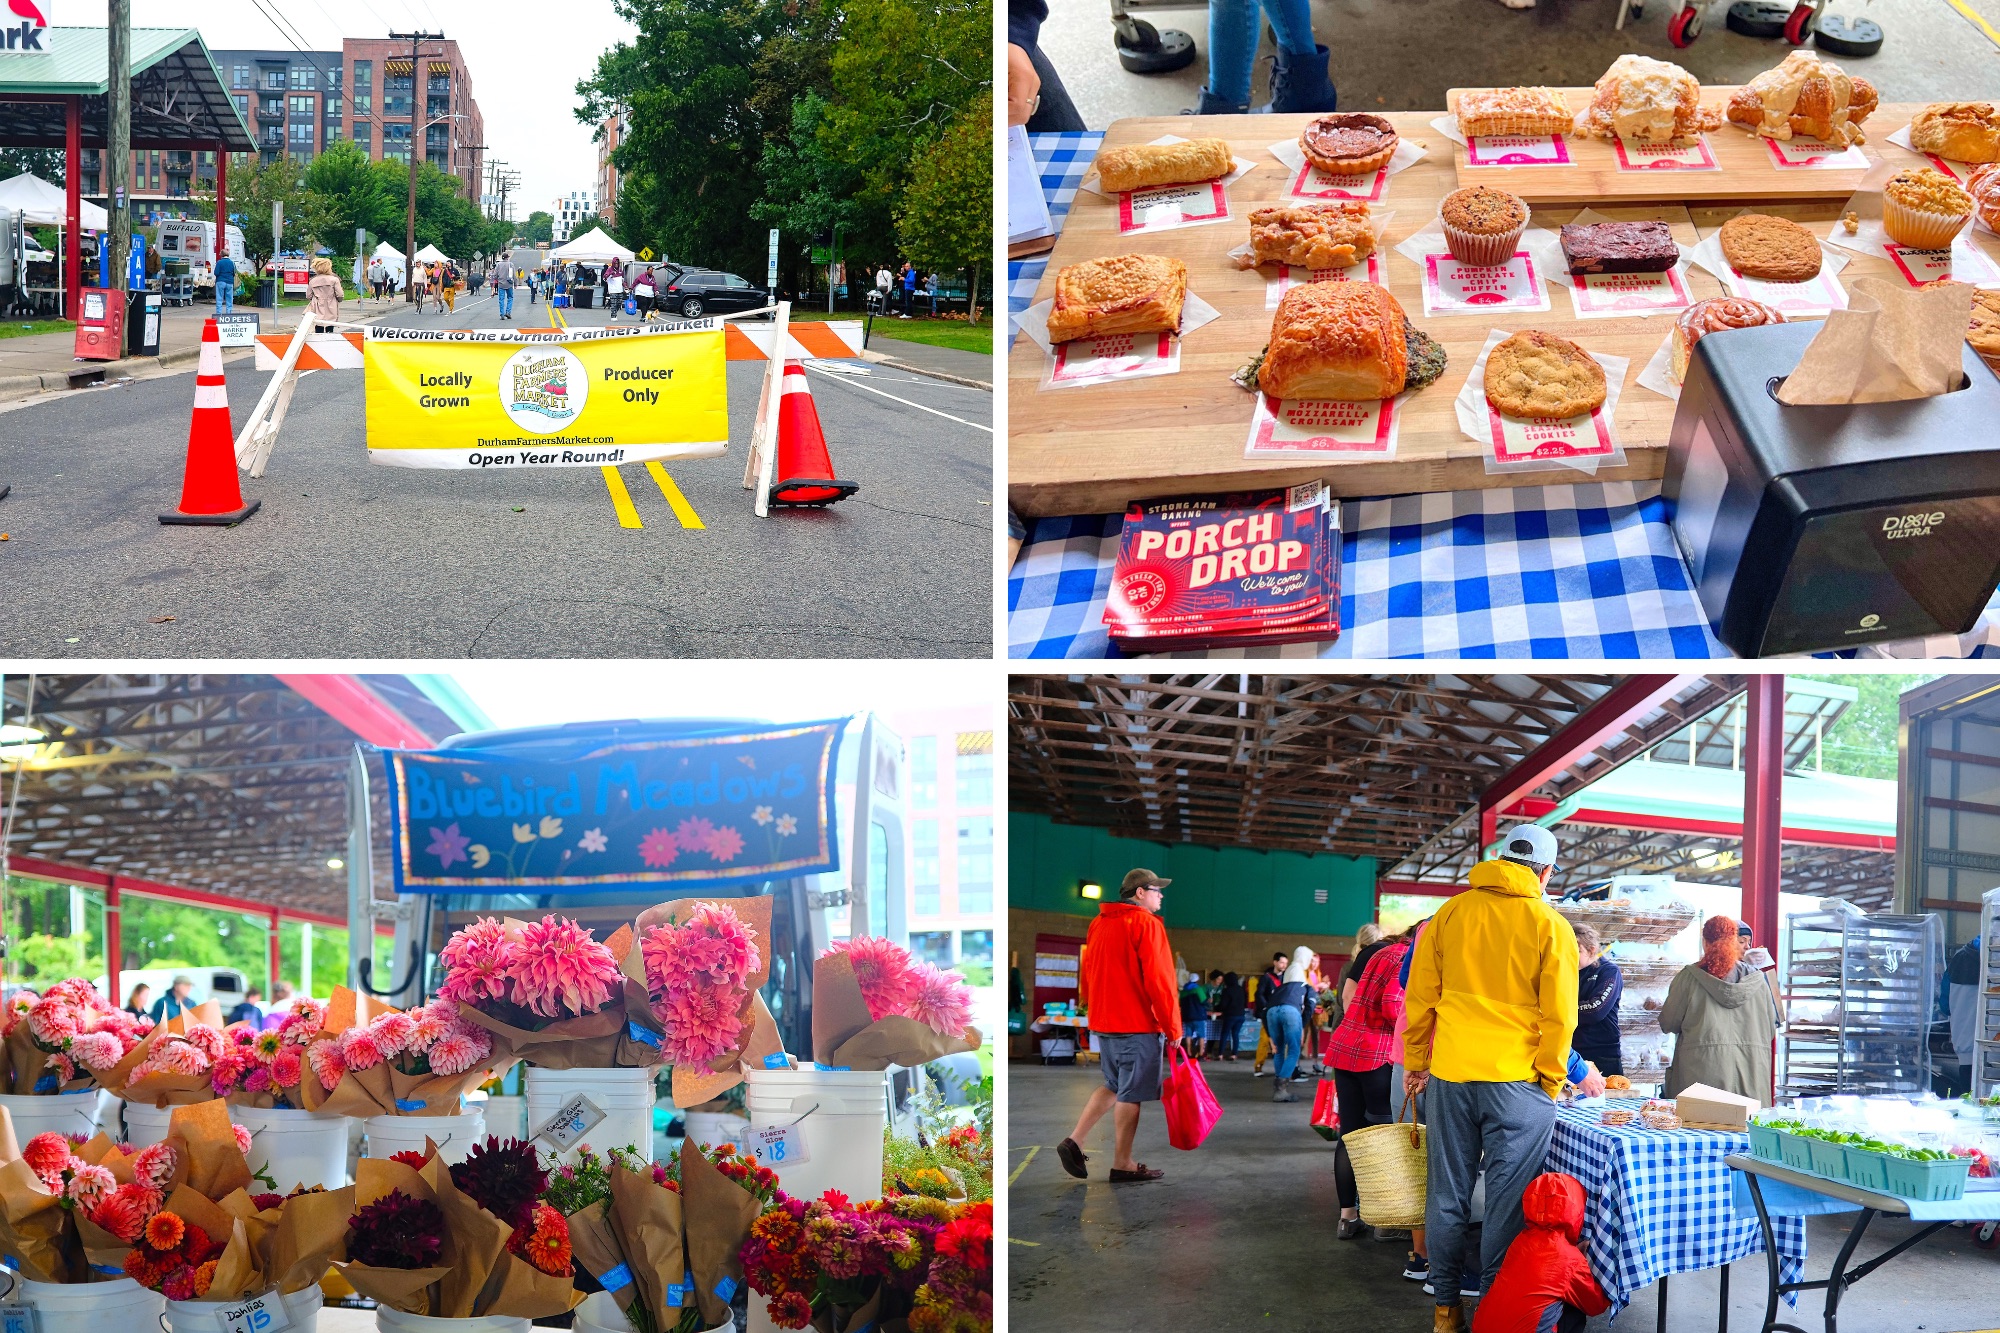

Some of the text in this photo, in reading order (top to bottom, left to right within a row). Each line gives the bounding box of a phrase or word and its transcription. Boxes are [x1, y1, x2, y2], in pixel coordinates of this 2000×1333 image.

[1133, 195, 1164, 205] STYLE
[166, 224, 201, 232] BUFFALO
[1450, 272, 1515, 280] CHOCOLATE
[372, 327, 444, 340] Welcome
[1096, 339, 1131, 347] SPICE
[1090, 345, 1134, 355] POTATO
[513, 357, 566, 377] DURHAM
[419, 372, 473, 389] Locally
[604, 367, 674, 381] Producer
[419, 395, 470, 408] Grown
[513, 389, 568, 409] MARKET
[622, 389, 660, 405] Only
[1298, 402, 1355, 410] SPINACH
[1286, 410, 1369, 418] MOZZARELLA
[1533, 416, 1560, 425] CHIP
[1289, 418, 1364, 426] CROISSANT
[1523, 422, 1572, 433] SEASALT
[477, 436, 614, 447] DurhamFarmersMarket.com
[1526, 430, 1576, 440] COOKIES
[1311, 438, 1330, 448] $6.
[1536, 446, 1565, 456] $2.25
[468, 449, 624, 467] Open Year Round!
[1148, 501, 1217, 515] STRONG ARM
[1161, 510, 1202, 520] BAKING
[1136, 512, 1274, 560] PORCH
[1886, 526, 1932, 540] ULTRA
[1189, 541, 1303, 589] DROP
[1240, 572, 1303, 592] We'll come
[1270, 575, 1310, 596] to you!
[409, 760, 807, 820] Bluebird Meadows
[546, 1100, 582, 1133] Sierra Glow
[569, 1116, 586, 1133] 18
[759, 1128, 787, 1138] Sierra
[765, 1136, 784, 1144] Glow
[755, 1140, 786, 1162] $ 18
[225, 1299, 265, 1322] Dahlias
